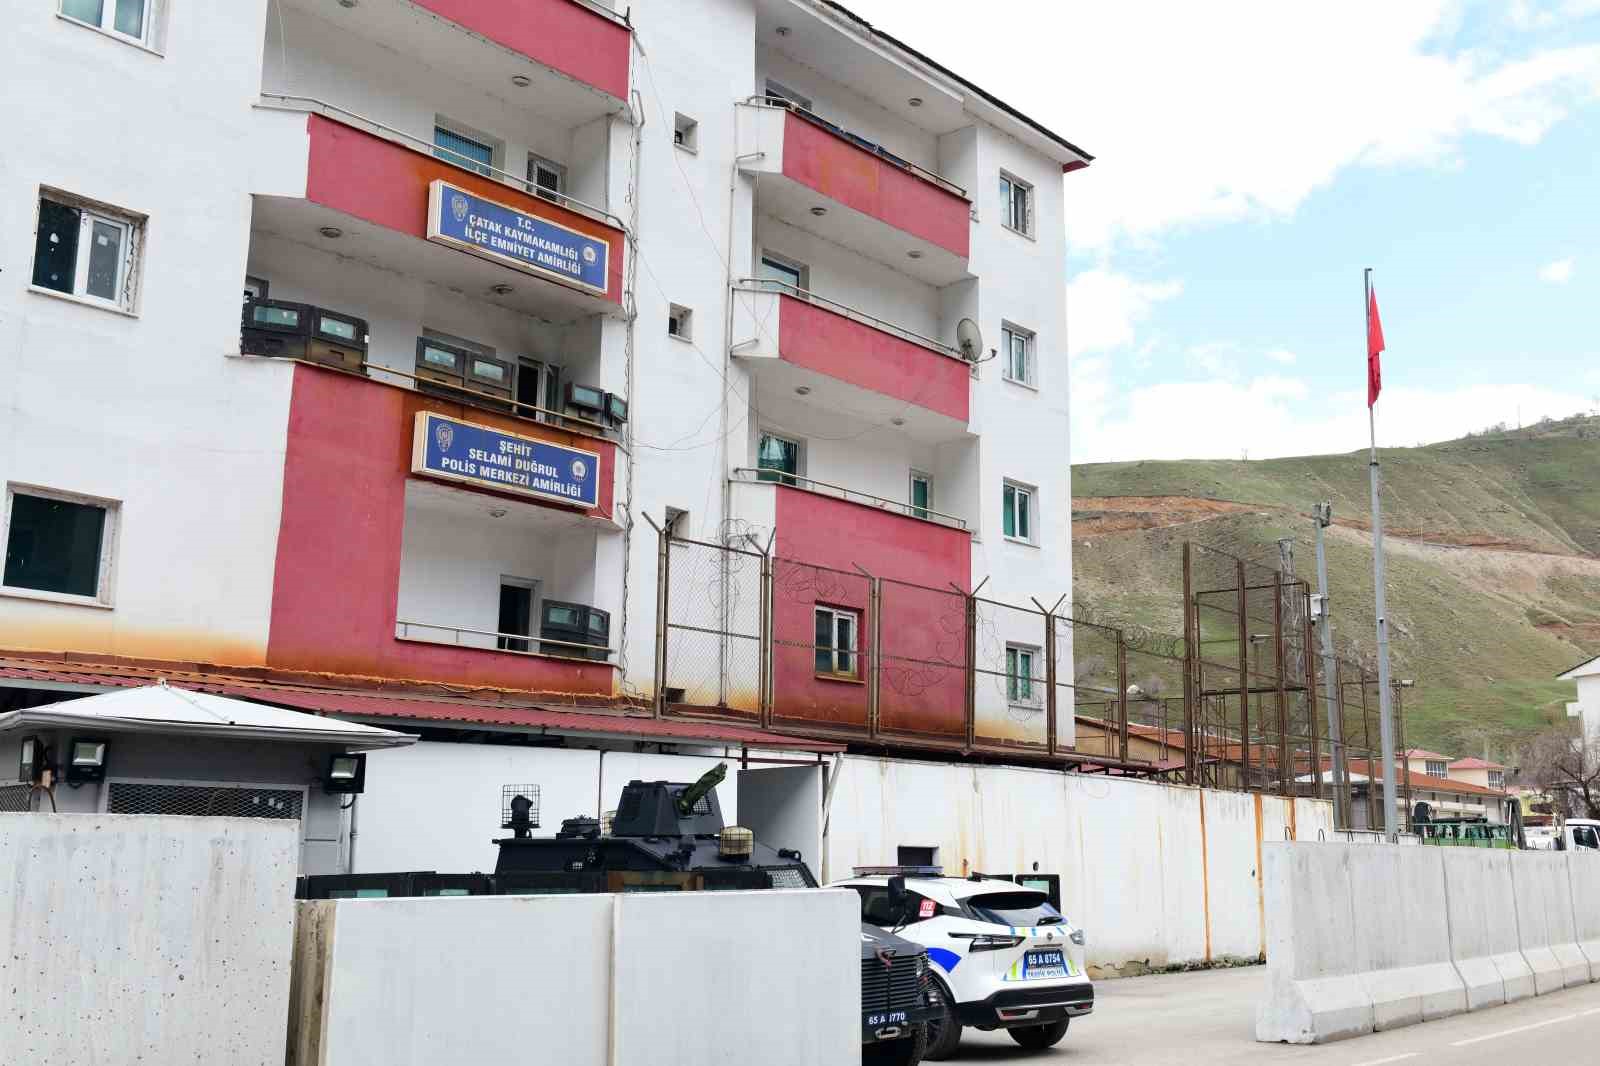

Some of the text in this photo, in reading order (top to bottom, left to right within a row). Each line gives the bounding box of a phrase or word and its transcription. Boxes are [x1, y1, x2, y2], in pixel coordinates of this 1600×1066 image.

[516, 216, 535, 232] T.C.
[464, 223, 581, 275] İLÇE EMNİYET AMİRLİĞİ
[469, 214, 578, 260] ÇATAK KAYMAKAMLIĞI
[499, 440, 533, 457] ŞEHİT
[468, 448, 559, 479] SELAMİ DUĞRUL
[441, 457, 581, 497] POLİS MERKEZİ AMİRLİĞİ
[1028, 954, 1037, 964] 65
[1038, 954, 1044, 964] A
[868, 1016, 878, 1025] 65
[880, 1015, 886, 1024] A
